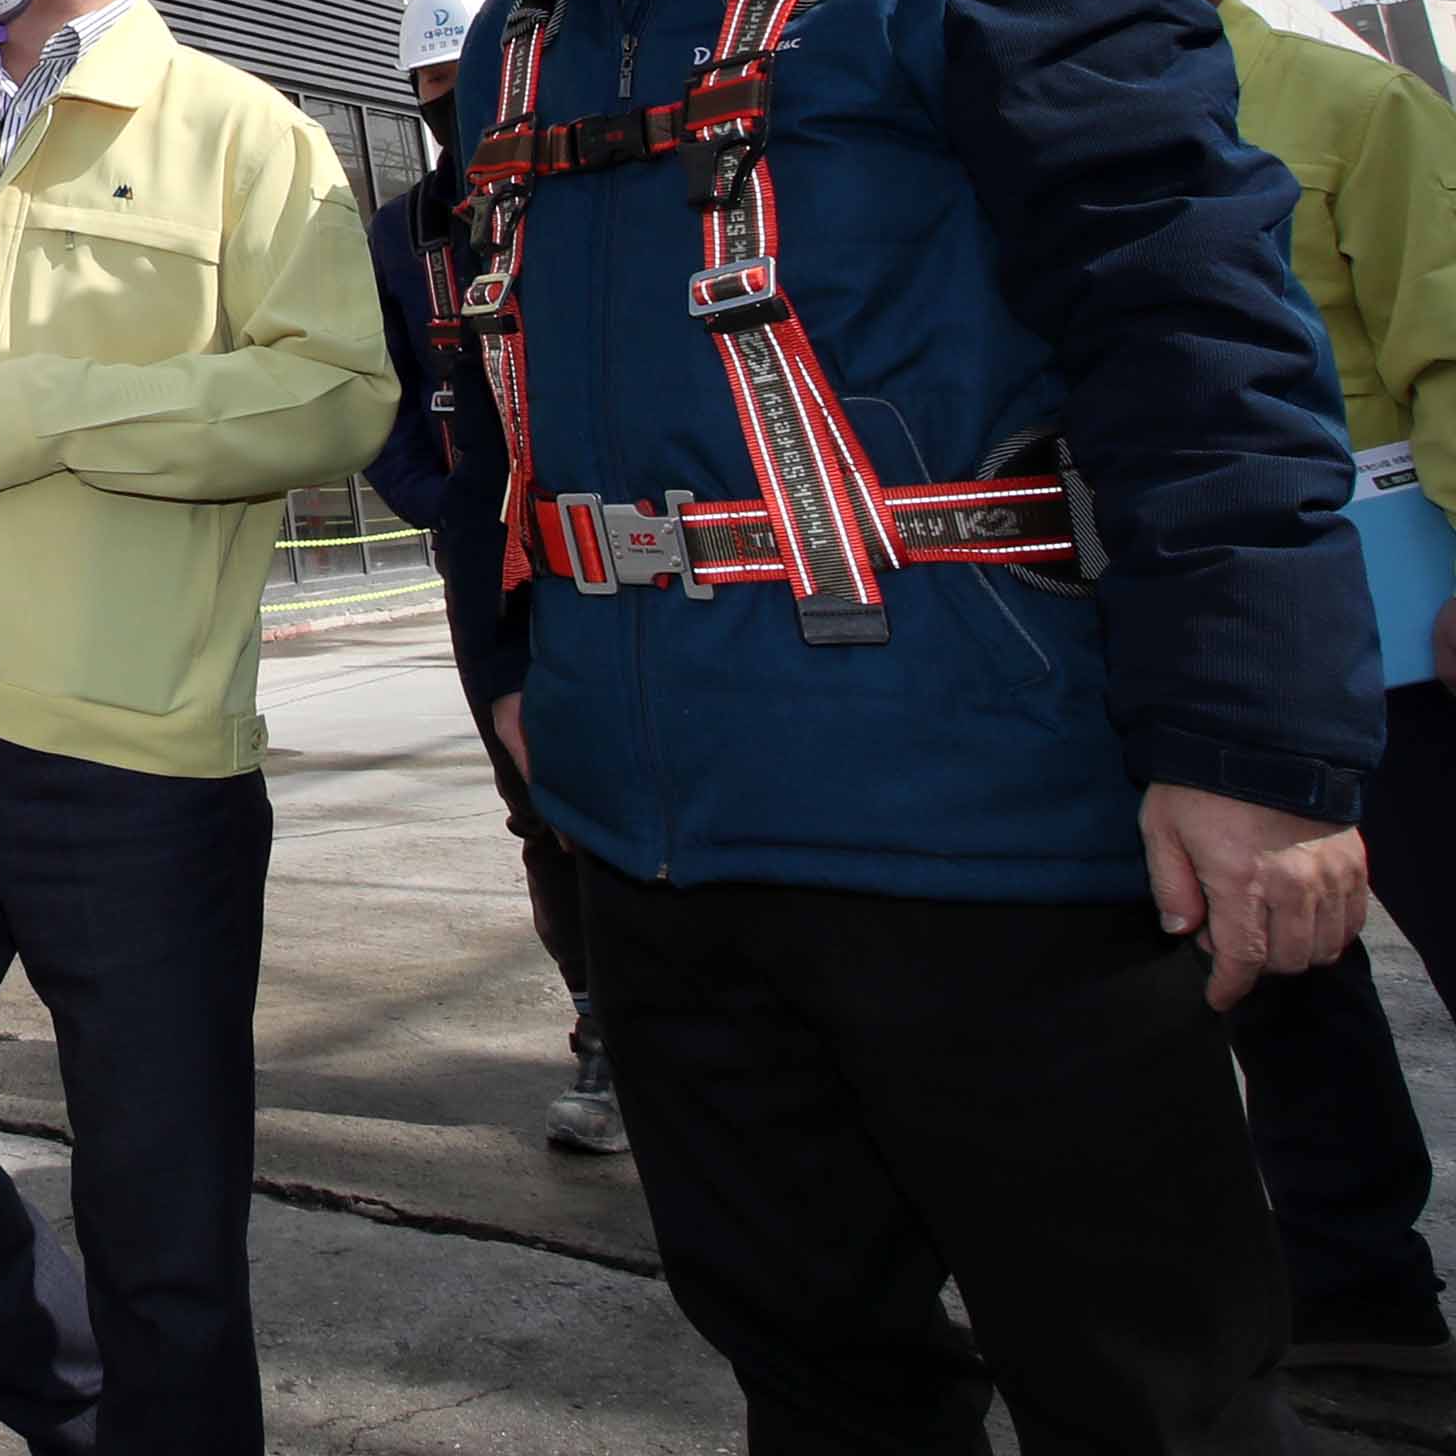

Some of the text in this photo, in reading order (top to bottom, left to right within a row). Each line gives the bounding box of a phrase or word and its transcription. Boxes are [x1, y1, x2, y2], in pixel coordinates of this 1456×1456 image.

[763, 392, 806, 480] Safety
[629, 533, 657, 546] K2
[793, 484, 827, 548] Think
